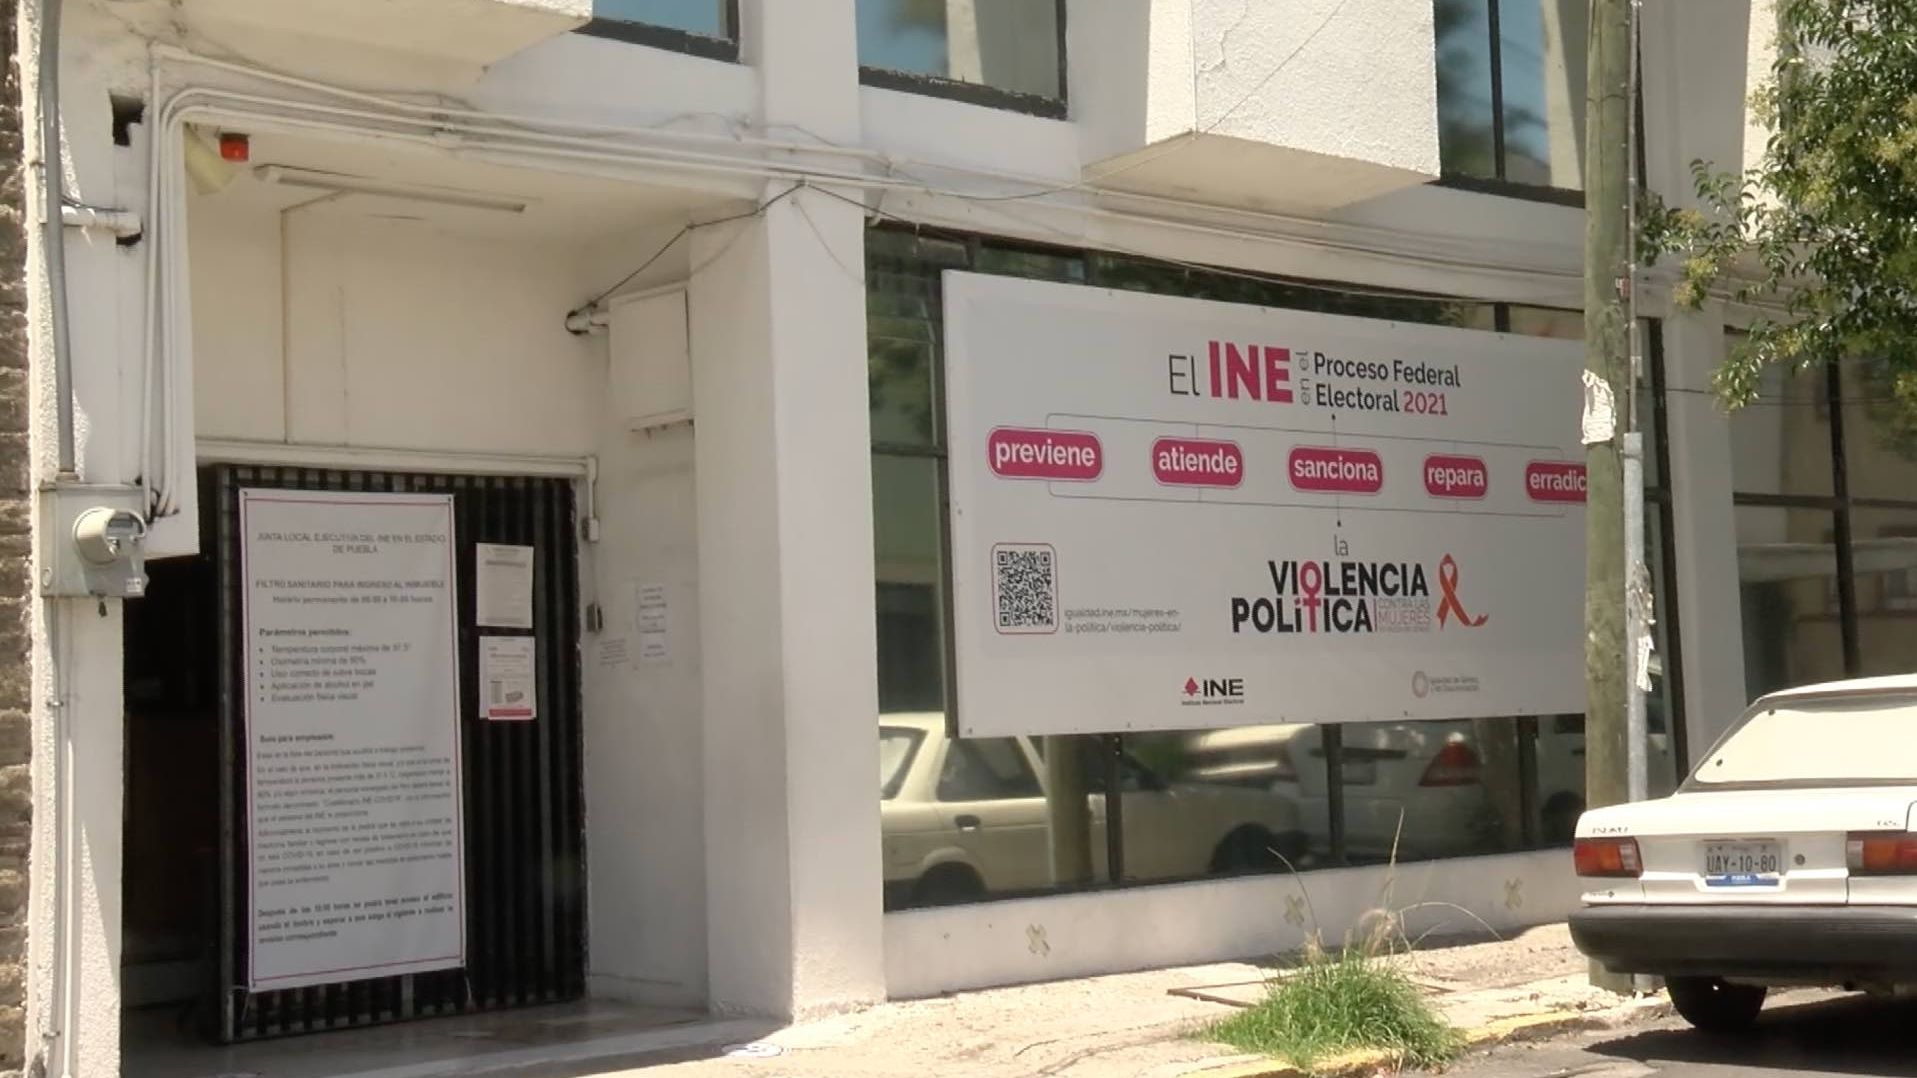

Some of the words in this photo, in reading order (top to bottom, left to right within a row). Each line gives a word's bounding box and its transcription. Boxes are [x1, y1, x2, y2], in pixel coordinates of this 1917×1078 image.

[1168, 354, 1200, 396] El
[1208, 340, 1293, 404] INE
[1313, 351, 1389, 382] Proceso
[1393, 359, 1461, 388] Federal
[1315, 383, 1400, 412] Electoral
[1403, 390, 1449, 416] 2021
[994, 438, 1096, 469] previene
[1157, 446, 1238, 474] atiende
[1293, 455, 1379, 482] sanciona
[1426, 466, 1485, 491] repara
[1529, 470, 1587, 492] erradic
[1334, 534, 1350, 557] la
[1267, 560, 1430, 598] VIOLENCIA
[1202, 678, 1244, 697] INE
[1706, 854, 1777, 873] UAY-10-80
